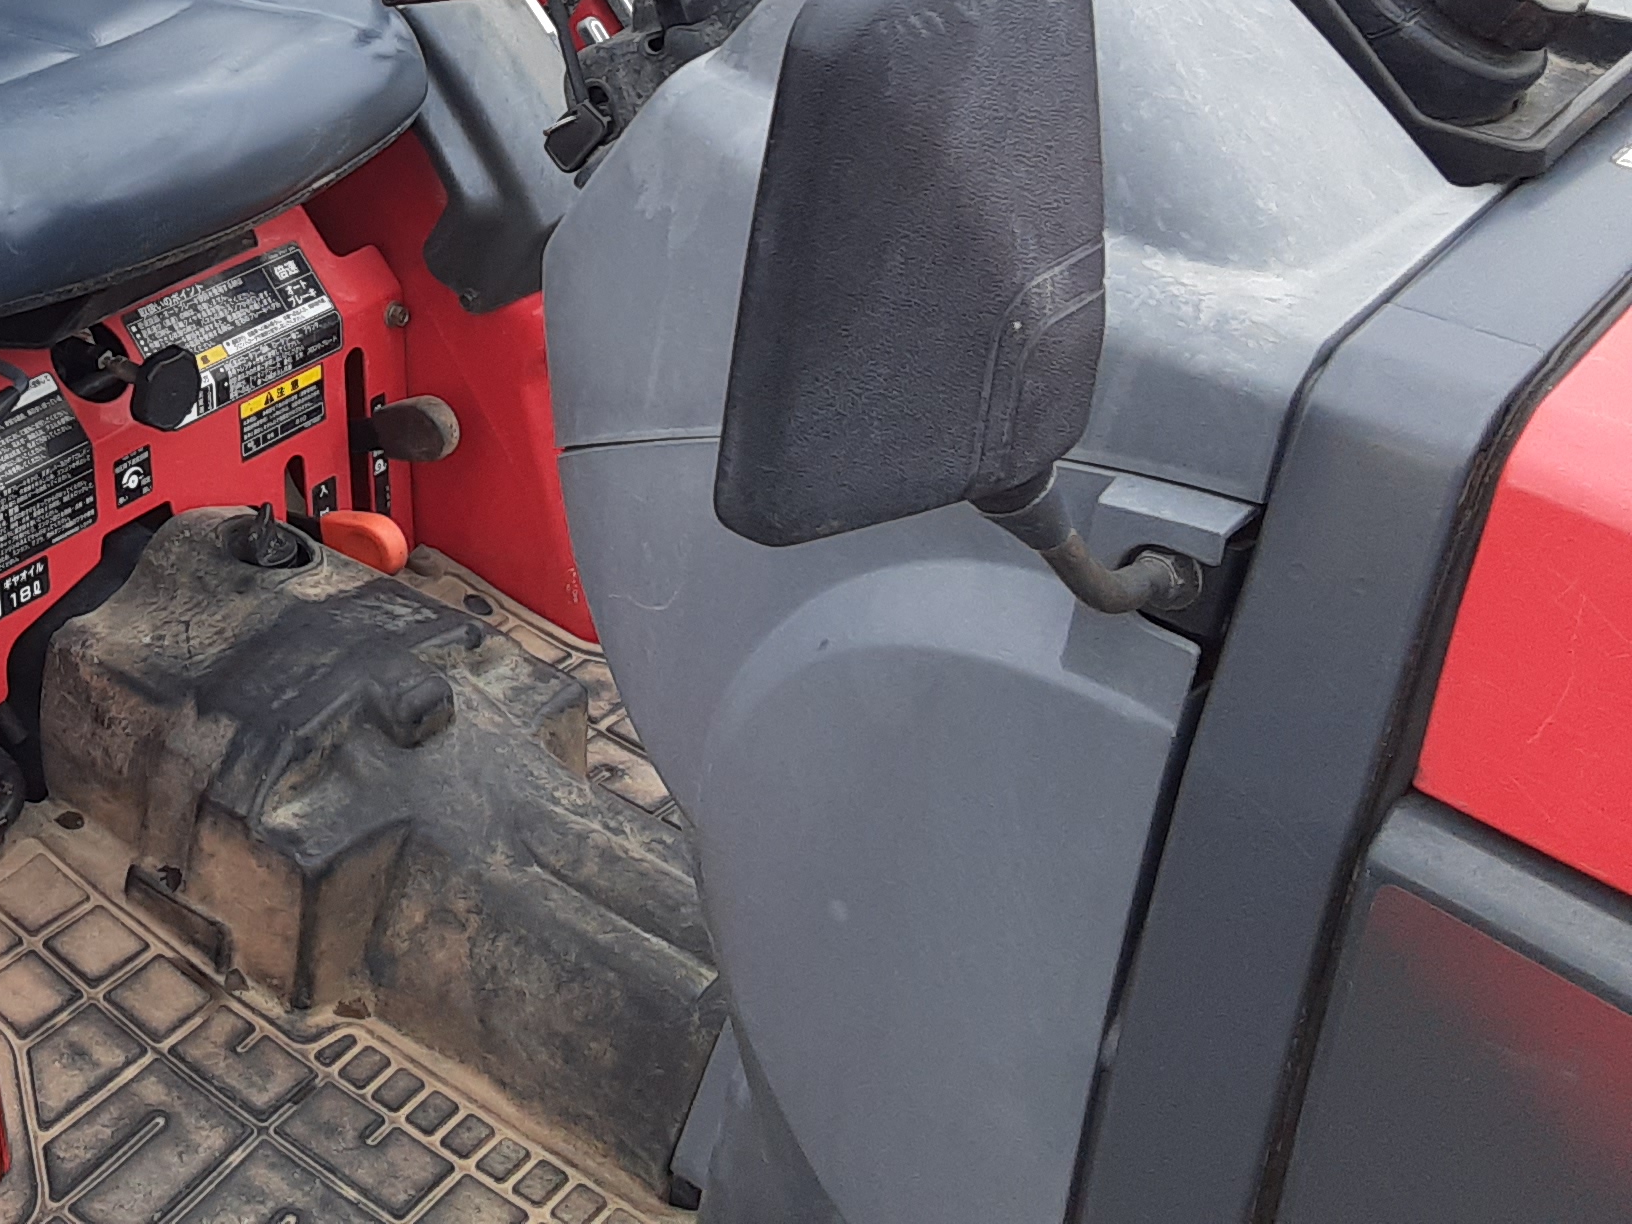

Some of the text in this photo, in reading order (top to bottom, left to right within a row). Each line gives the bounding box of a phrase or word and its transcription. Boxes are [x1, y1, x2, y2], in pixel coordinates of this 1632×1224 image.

[274, 260, 300, 280] 倍速
[284, 279, 308, 296] オート
[287, 288, 317, 307] ブレーキ
